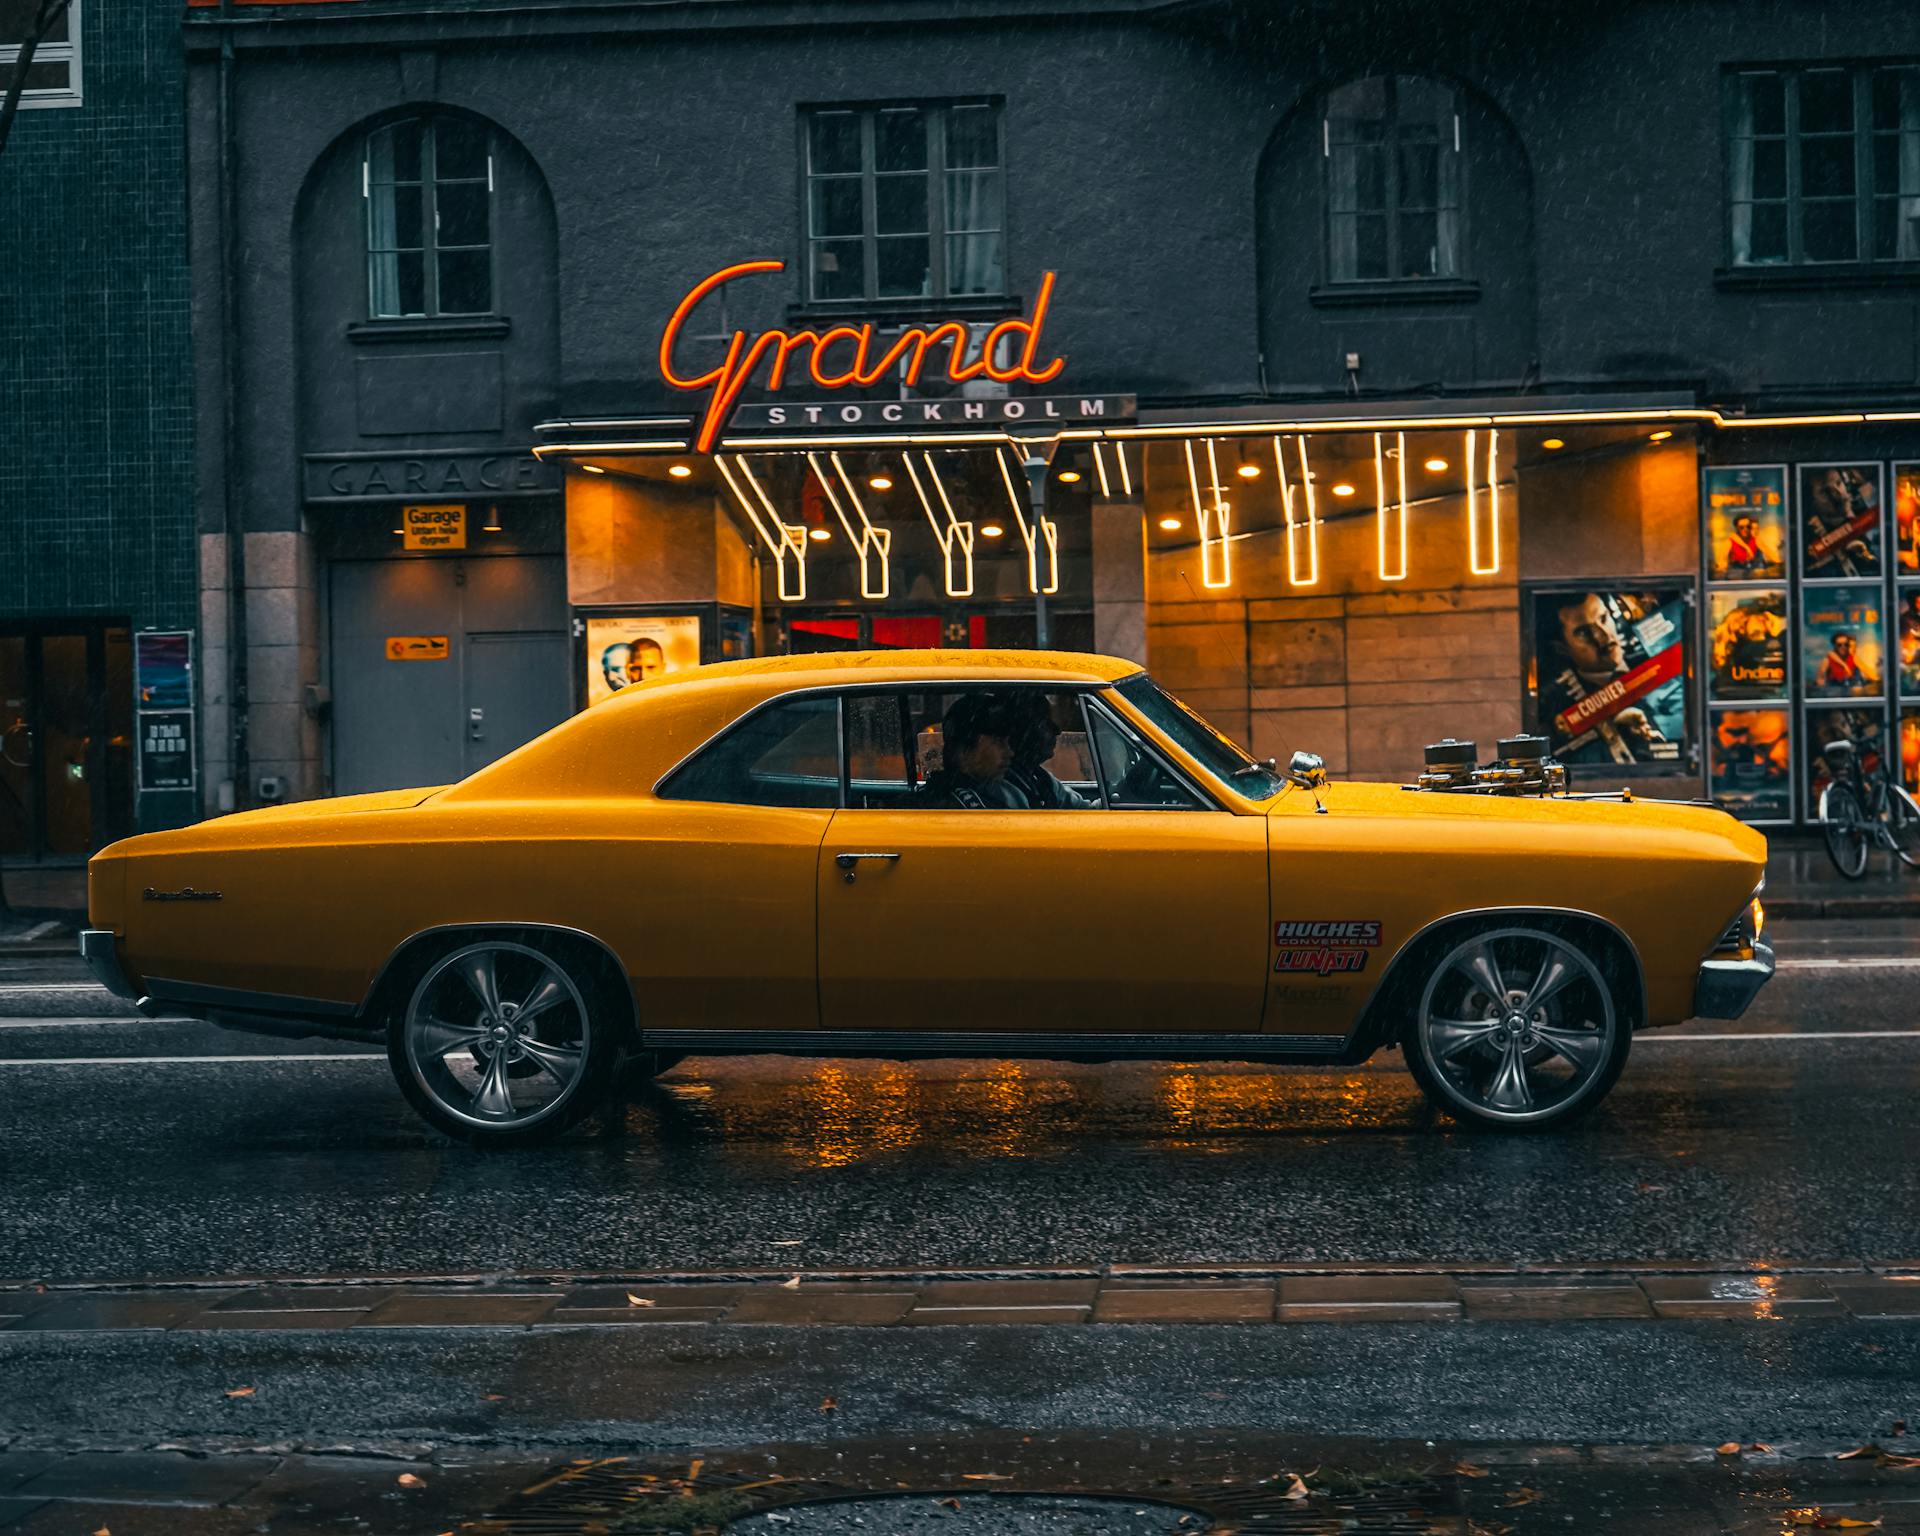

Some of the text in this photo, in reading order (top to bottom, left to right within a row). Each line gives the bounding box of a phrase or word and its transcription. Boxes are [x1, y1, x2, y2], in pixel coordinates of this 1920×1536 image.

[659, 259, 1066, 453] Grand
[767, 399, 1106, 426] STOCKHOLM
[330, 457, 538, 494] GARAGE
[408, 509, 461, 526] Garage
[419, 536, 451, 545] dygnet
[1731, 665, 1785, 681] Undine
[1577, 680, 1627, 717] COURIER
[1277, 922, 1380, 936] HUGHES
[1276, 948, 1364, 974] LUNATI
